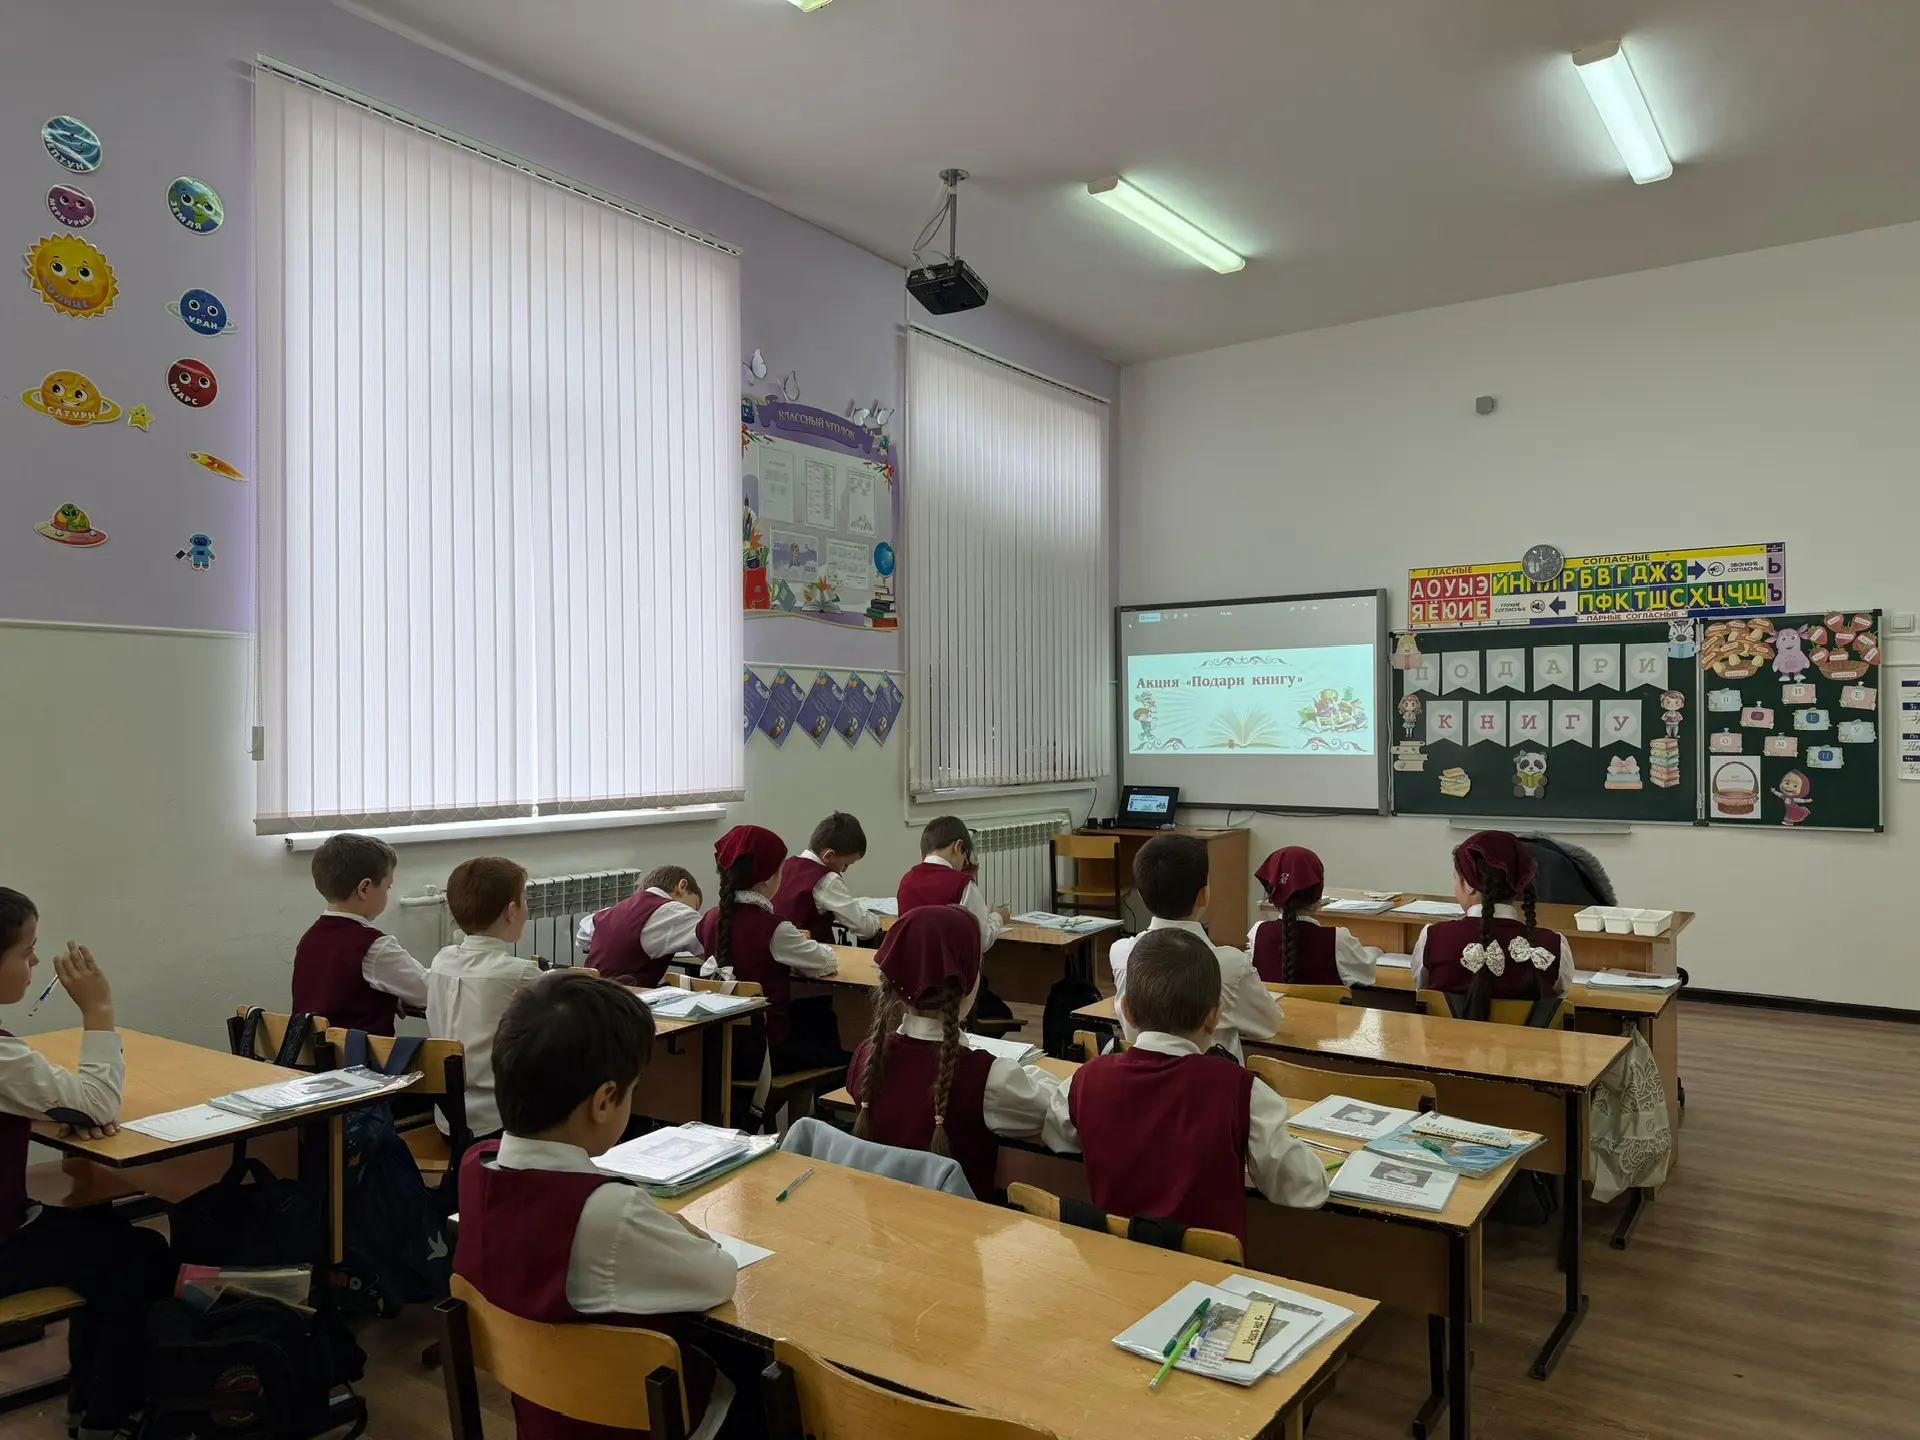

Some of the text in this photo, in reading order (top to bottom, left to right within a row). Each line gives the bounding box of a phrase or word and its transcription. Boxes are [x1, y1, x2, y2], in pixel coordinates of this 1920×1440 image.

[45, 135, 84, 170] НЕПТУН
[48, 197, 92, 227] МЕРКУРИЙ
[170, 199, 202, 230] ЗЕМЛЯ
[43, 277, 89, 309] СОЛНЦЕ
[188, 315, 218, 330] УРАН
[170, 382, 198, 405] МАРС
[47, 406, 97, 419] САТУРН
[778, 411, 856, 440] КЛАССНЫЙ УГОЛОК
[1582, 554, 1651, 566] СОГЛАСНЫЕ
[1768, 557, 1781, 573] Ь
[1427, 566, 1473, 576] ГЛАСНЫЕ
[1768, 583, 1783, 601] Ъ
[1586, 611, 1679, 622] ПАРНЫЕ СОГЛАСНЫЕ
[1136, 672, 1303, 690] Акция «Подари книгу»
